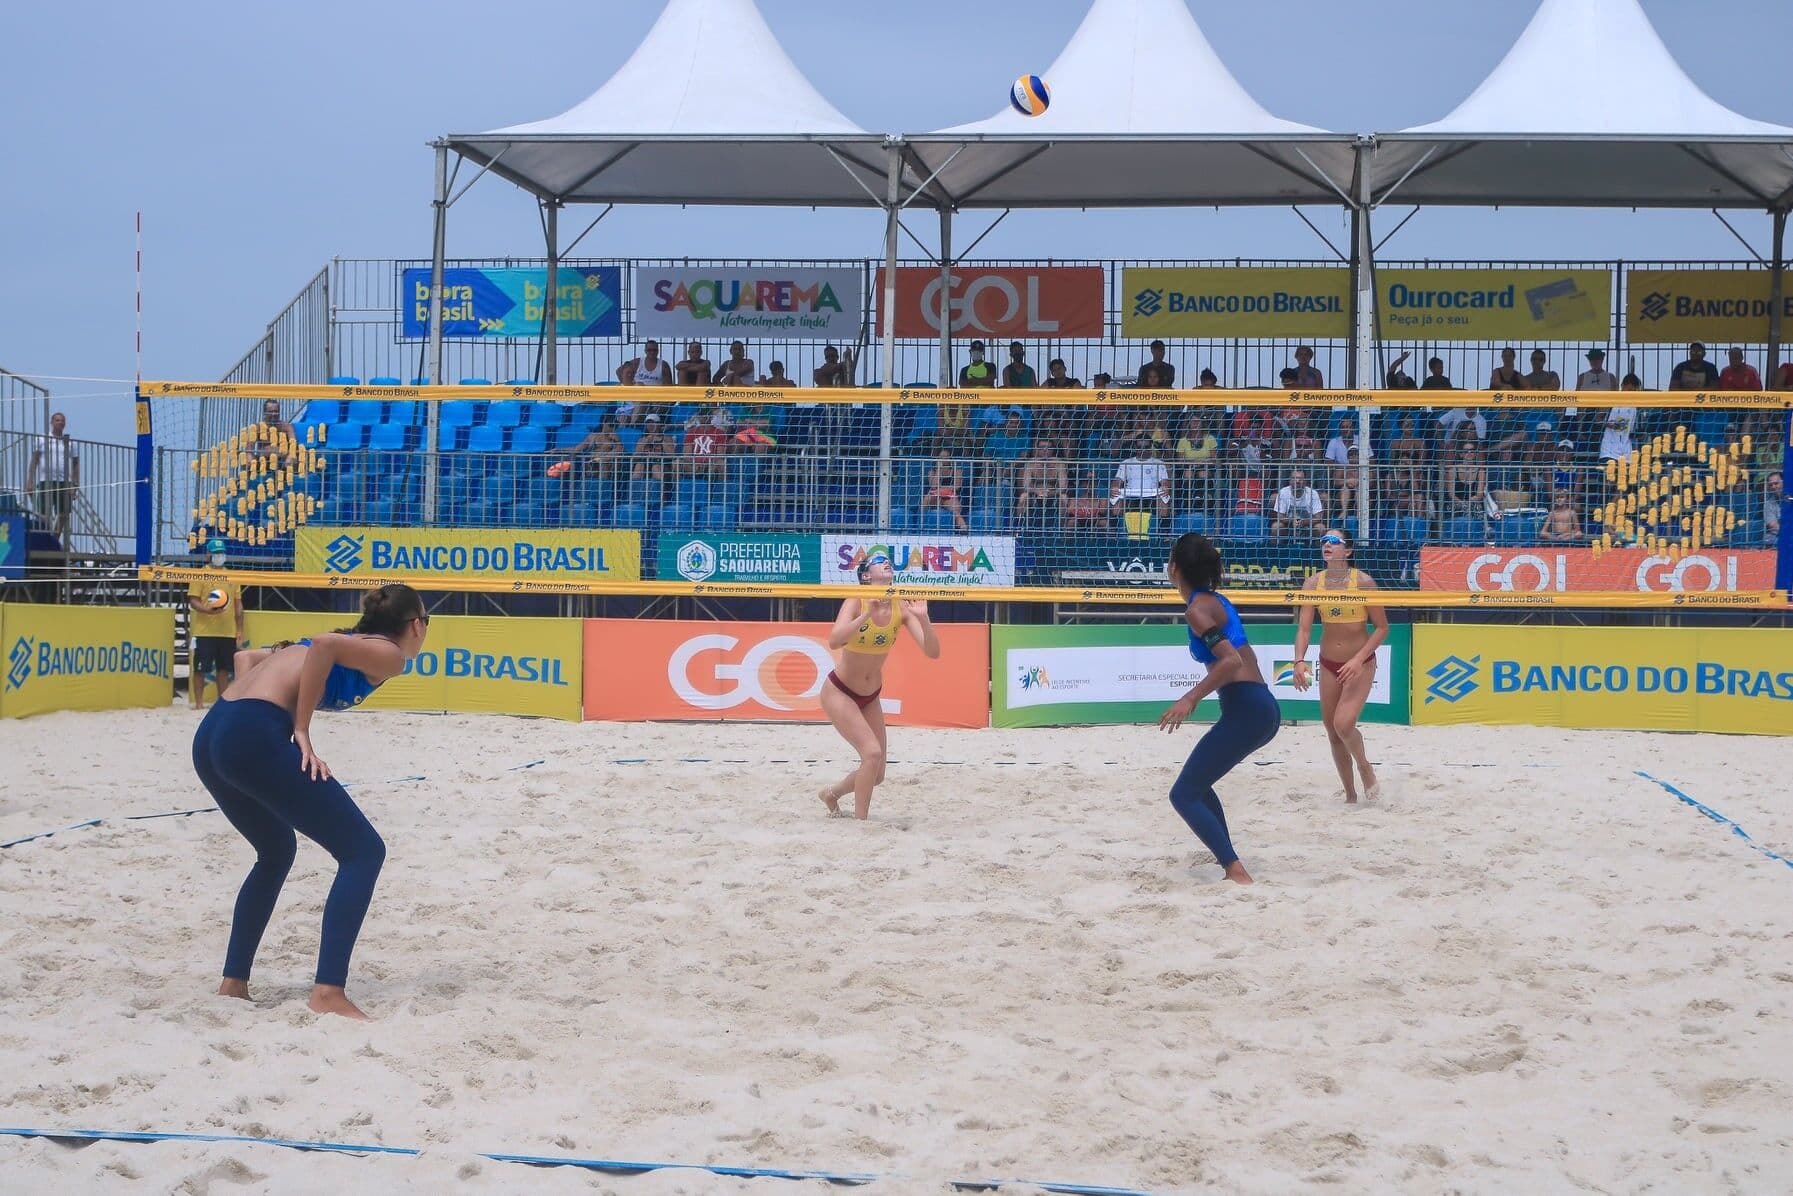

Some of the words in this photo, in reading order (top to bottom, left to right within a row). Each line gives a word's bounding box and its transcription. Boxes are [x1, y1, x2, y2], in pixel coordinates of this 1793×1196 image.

[654, 279, 843, 319] SAQUAREMA
[920, 275, 1059, 332] GOL
[1169, 292, 1239, 313] BANCO
[1243, 295, 1270, 312] DO
[1273, 292, 1344, 313] BRASIL
[1389, 283, 1515, 309] Ourocard
[1675, 296, 1748, 317] BANCO
[416, 302, 475, 321] basil
[524, 302, 585, 321] brsil
[720, 312, 796, 330] Naturalmente
[799, 314, 830, 330] linda!
[1389, 314, 1418, 326] Peça
[1422, 313, 1433, 326] já
[1436, 316, 1444, 324] o
[1447, 316, 1469, 325] seu
[371, 540, 466, 571] BANCO
[473, 546, 508, 571] DO
[514, 543, 609, 571] BRASIL
[720, 543, 800, 558] PREFEITURA
[838, 545, 994, 572] SAUAREMA
[720, 559, 800, 573] SAQUAREMA
[37, 642, 95, 677] BANCO
[98, 647, 118, 672] DO
[121, 641, 169, 679] BRASIL
[445, 648, 568, 686] BRASIL
[667, 634, 902, 715] GO
[1492, 661, 1628, 693] BANCO
[1636, 666, 1688, 694] DO
[1696, 662, 1793, 701] BRAS
